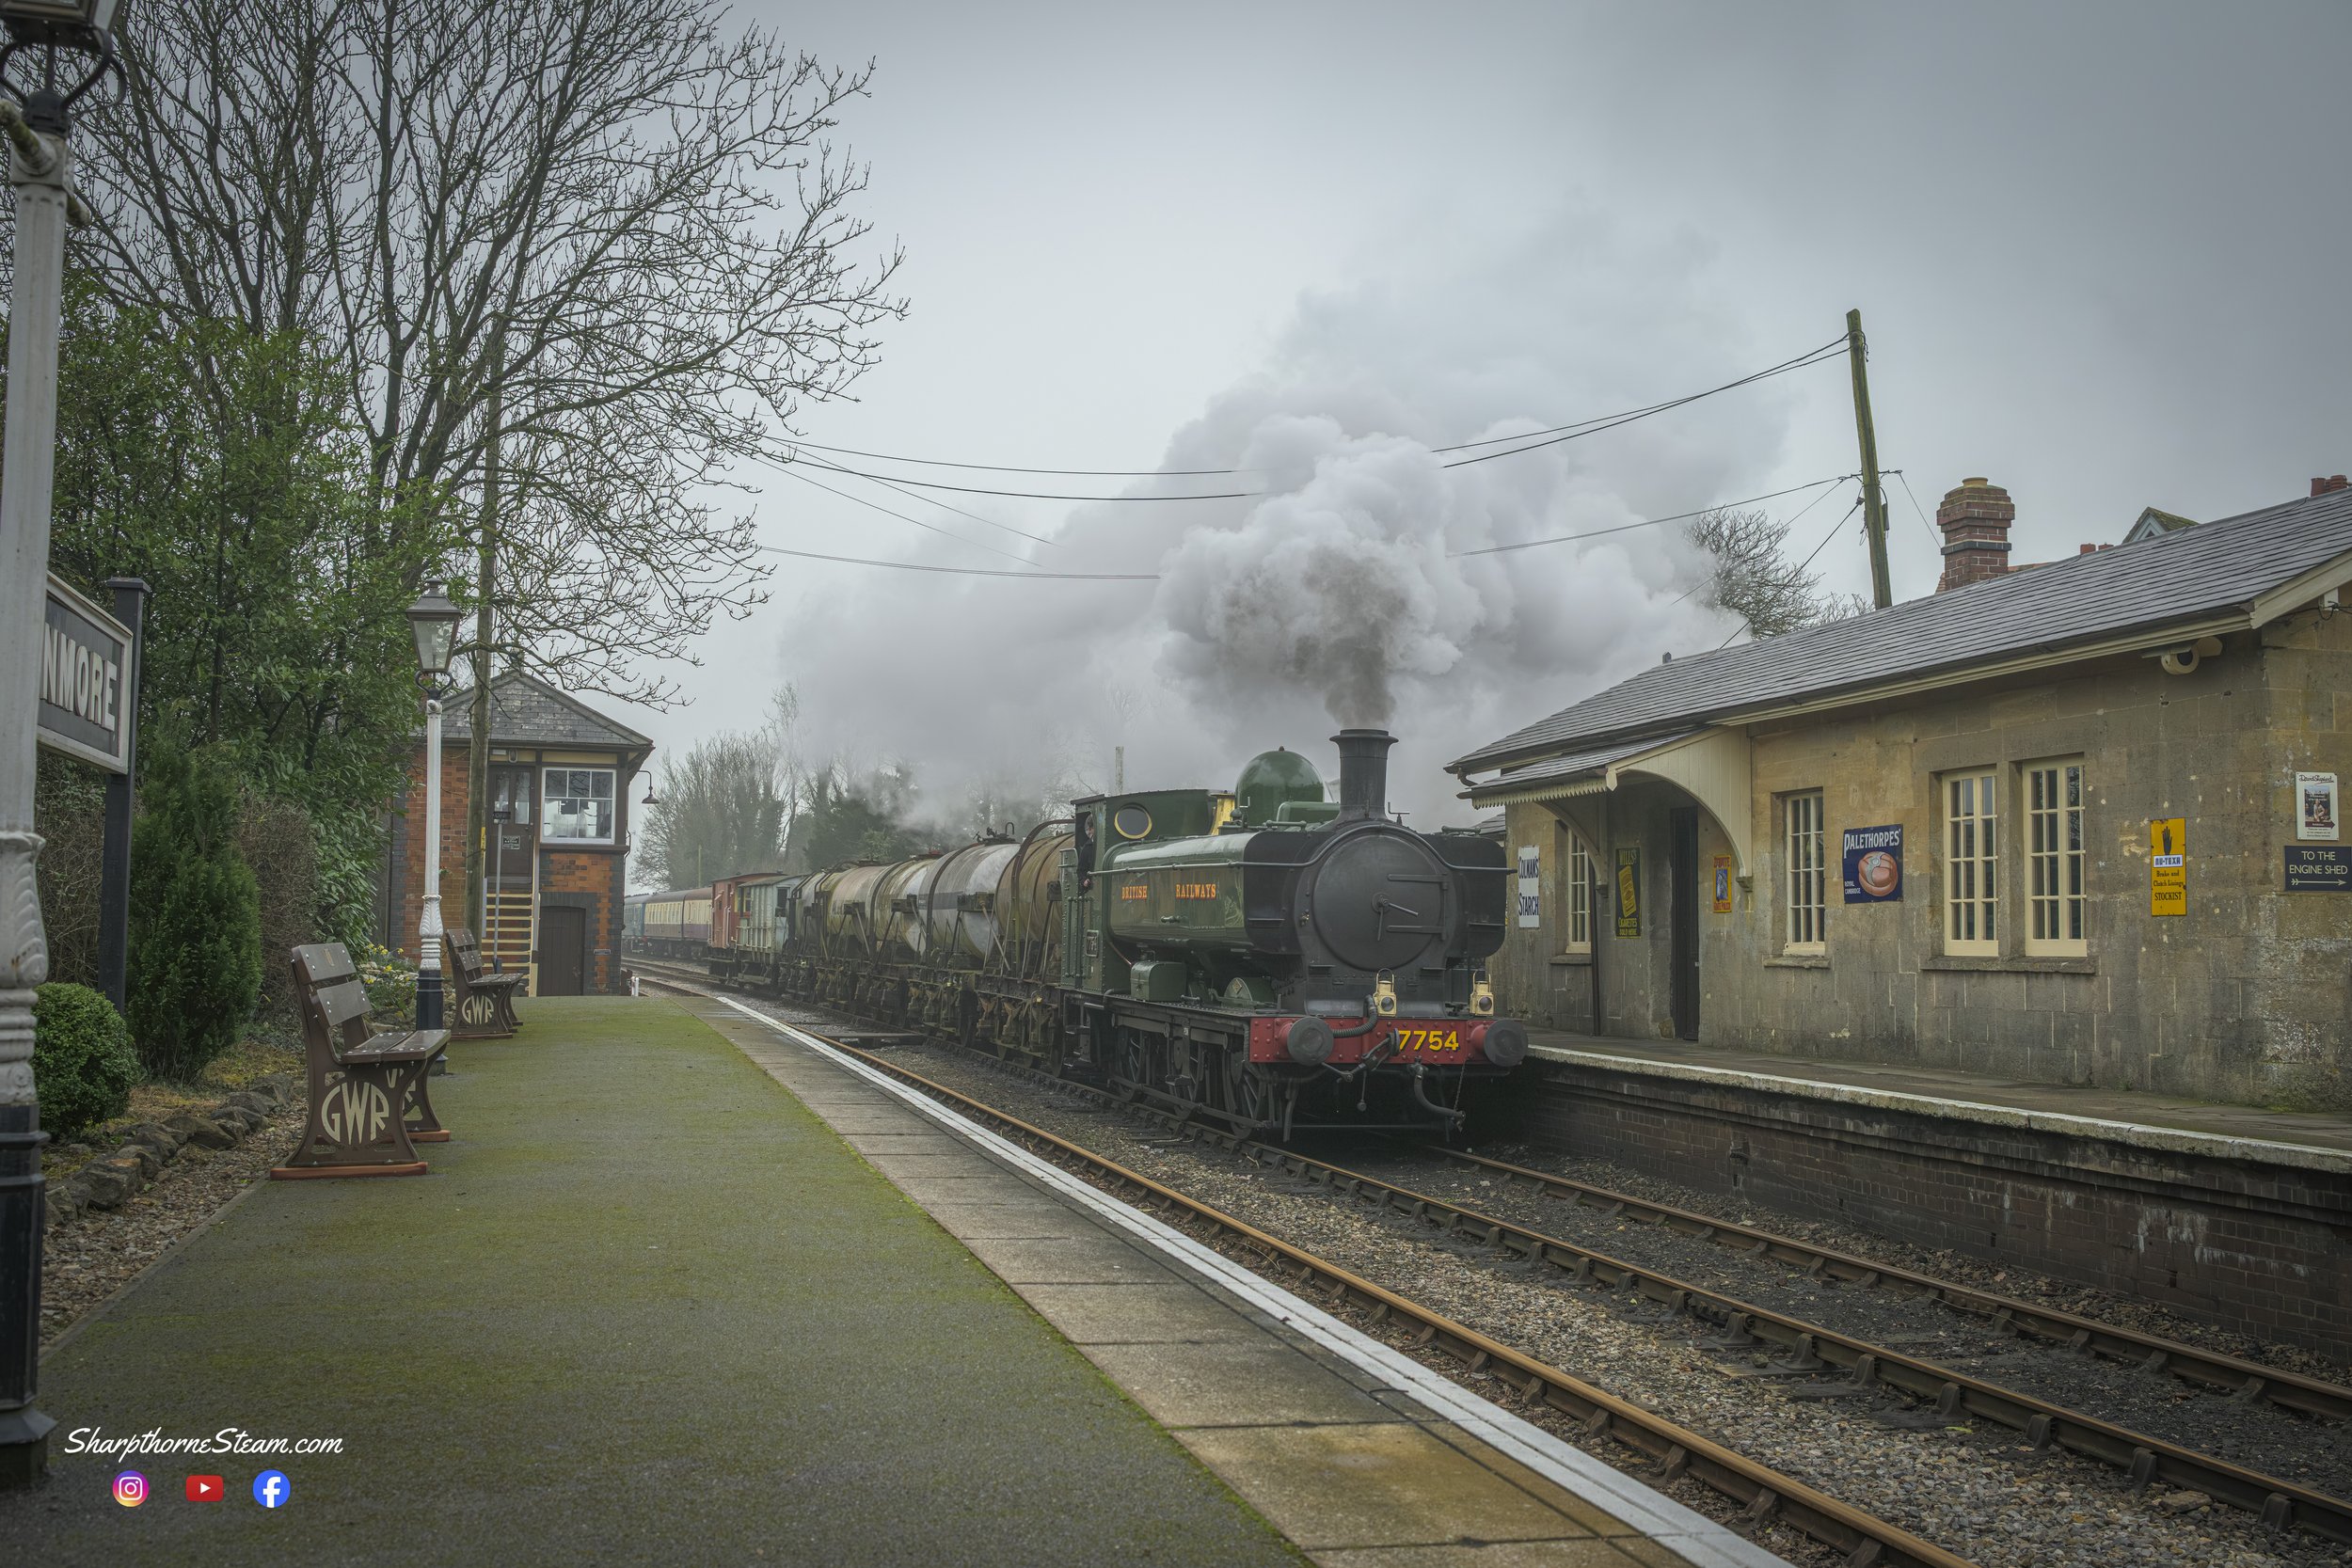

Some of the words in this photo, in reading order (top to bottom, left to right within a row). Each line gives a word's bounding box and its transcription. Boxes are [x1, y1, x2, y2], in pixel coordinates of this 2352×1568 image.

[2301, 851, 2314, 860] TO
[2317, 851, 2336, 860] THE
[2289, 865, 2322, 874] ENGINE
[2325, 865, 2348, 875] SHED
[1121, 885, 1148, 899] BRITISH
[1176, 883, 1216, 899] RAILWAYS
[2154, 892, 2182, 901] STOCKIST
[1518, 893, 1539, 916] STARCH
[462, 995, 494, 1025] GWR
[1399, 1030, 1459, 1051] 7754
[321, 1082, 389, 1145] GWR
